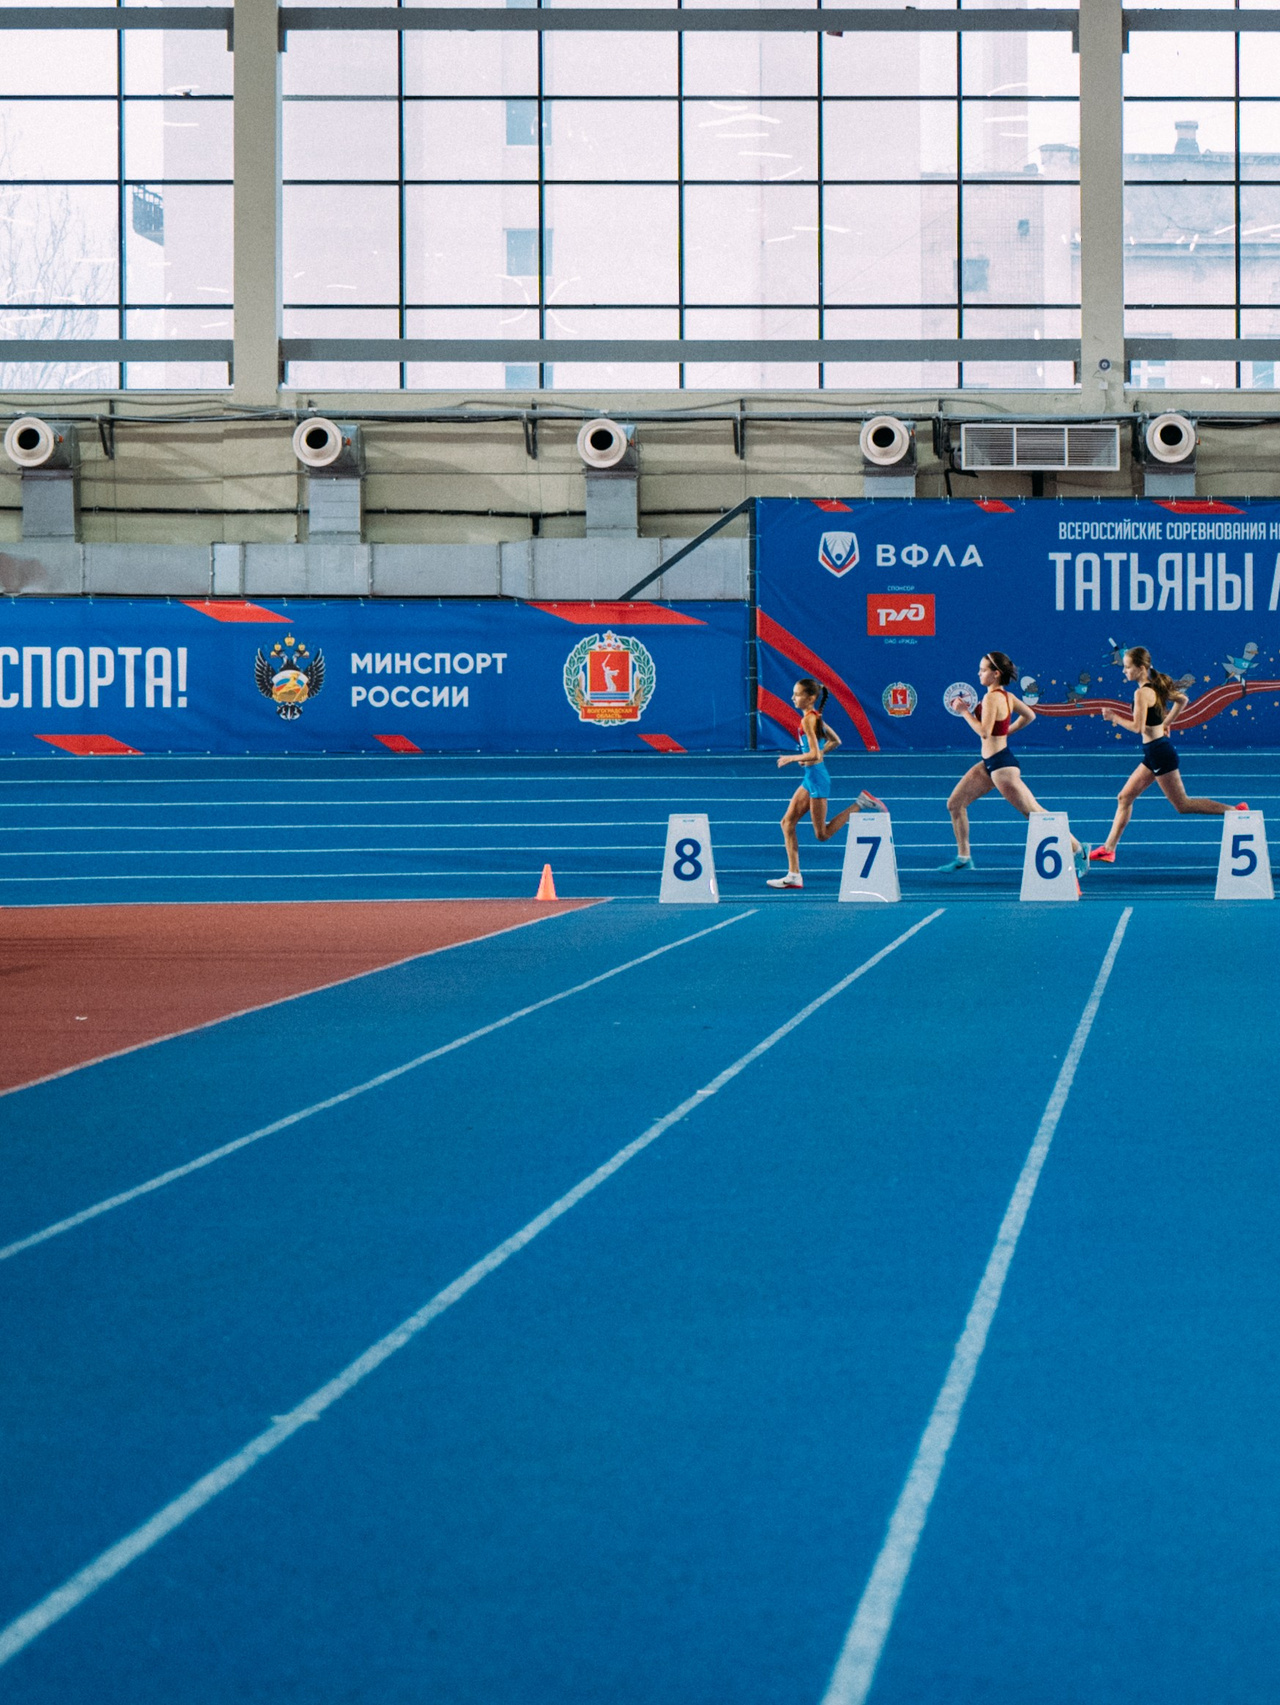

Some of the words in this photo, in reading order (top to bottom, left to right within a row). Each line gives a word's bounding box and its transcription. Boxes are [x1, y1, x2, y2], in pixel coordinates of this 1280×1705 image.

[1059, 519, 1163, 540] ВСЕРОССИЙСКИЕ
[1166, 522, 1266, 540] СОРЕВНОВАНИЯ
[876, 543, 984, 568] ВФЛА
[1049, 552, 1254, 611] ТАТЬЯНЫ
[0, 646, 188, 708] СПОРТА!
[351, 652, 508, 674] МИНСПОРТ
[351, 685, 469, 708] РОССИИ
[673, 838, 703, 882] 8
[857, 836, 882, 879] 7
[1034, 836, 1063, 880] 6
[1231, 834, 1257, 878] 5
